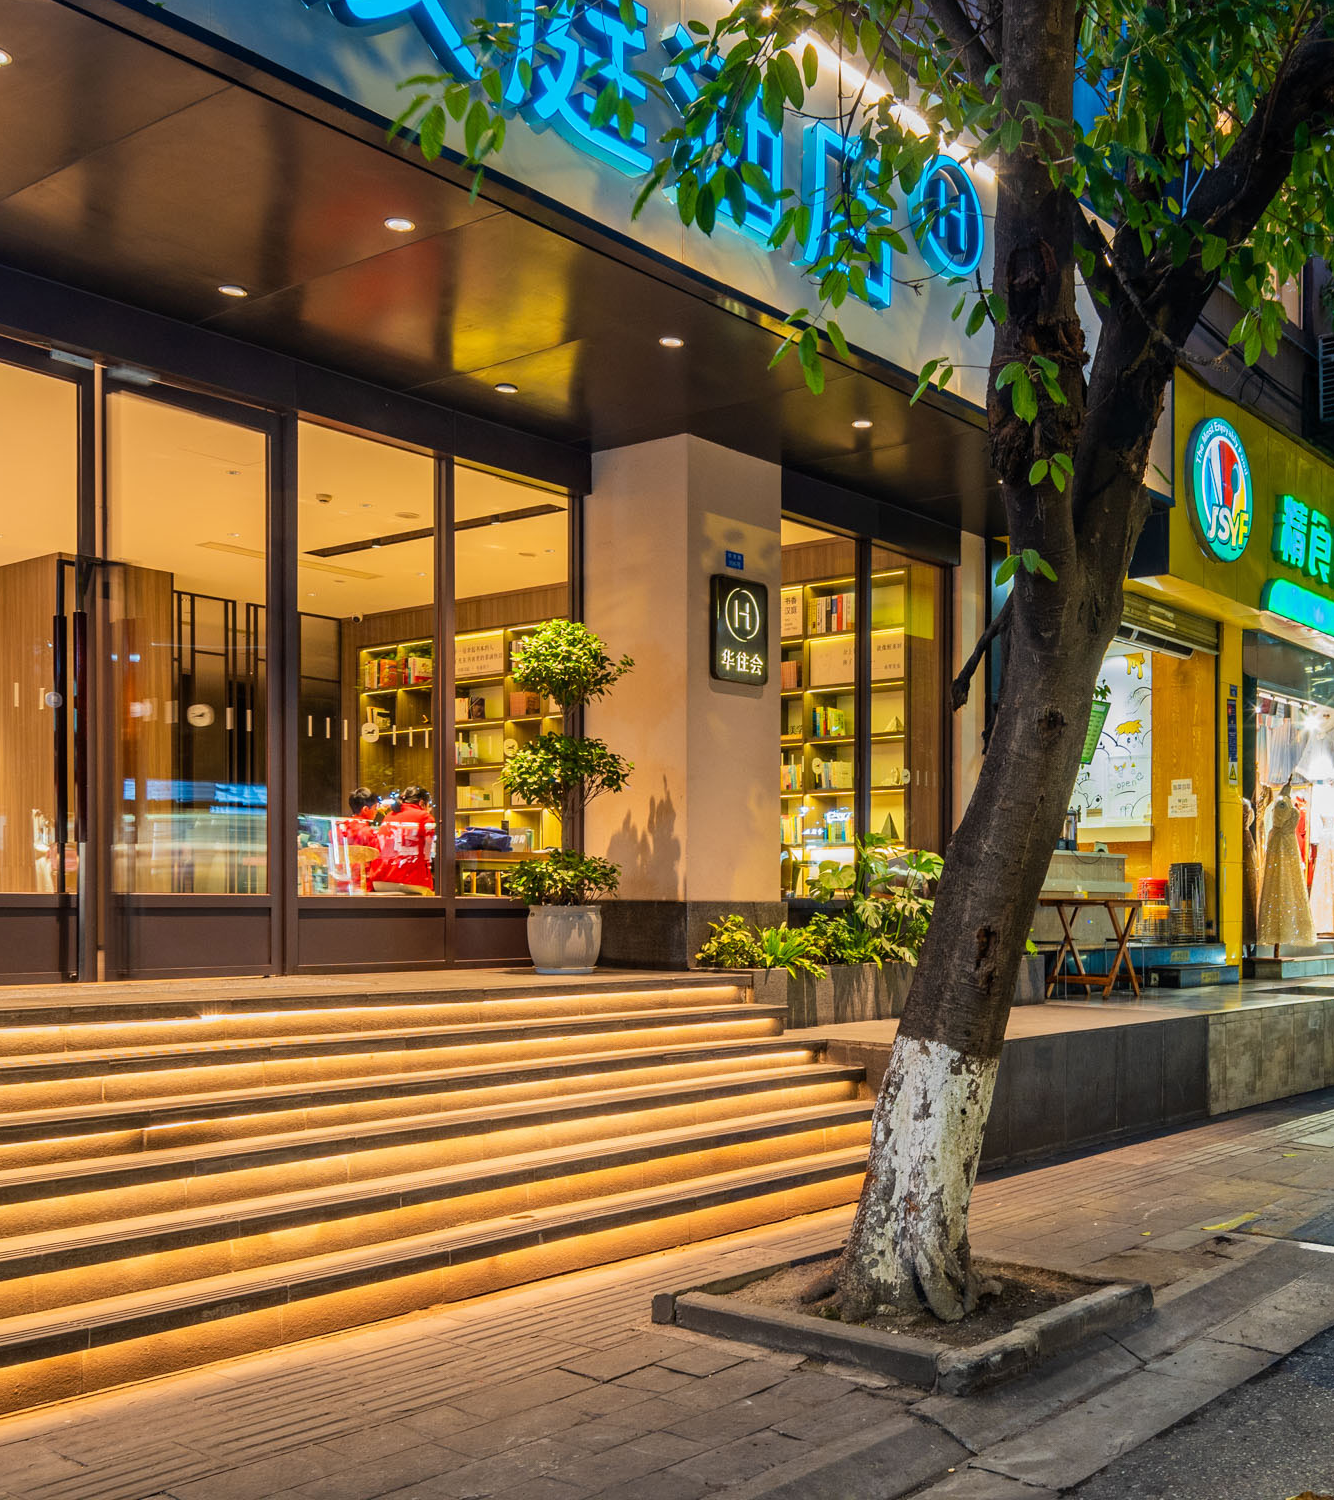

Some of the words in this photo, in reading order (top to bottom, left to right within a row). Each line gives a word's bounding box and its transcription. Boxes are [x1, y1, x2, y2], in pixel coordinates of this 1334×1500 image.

[1196, 444, 1205, 464] The
[1202, 423, 1214, 444] Most
[1207, 505, 1249, 547] JSYF
[721, 648, 764, 676] 华住会
[1116, 780, 1137, 790] open
